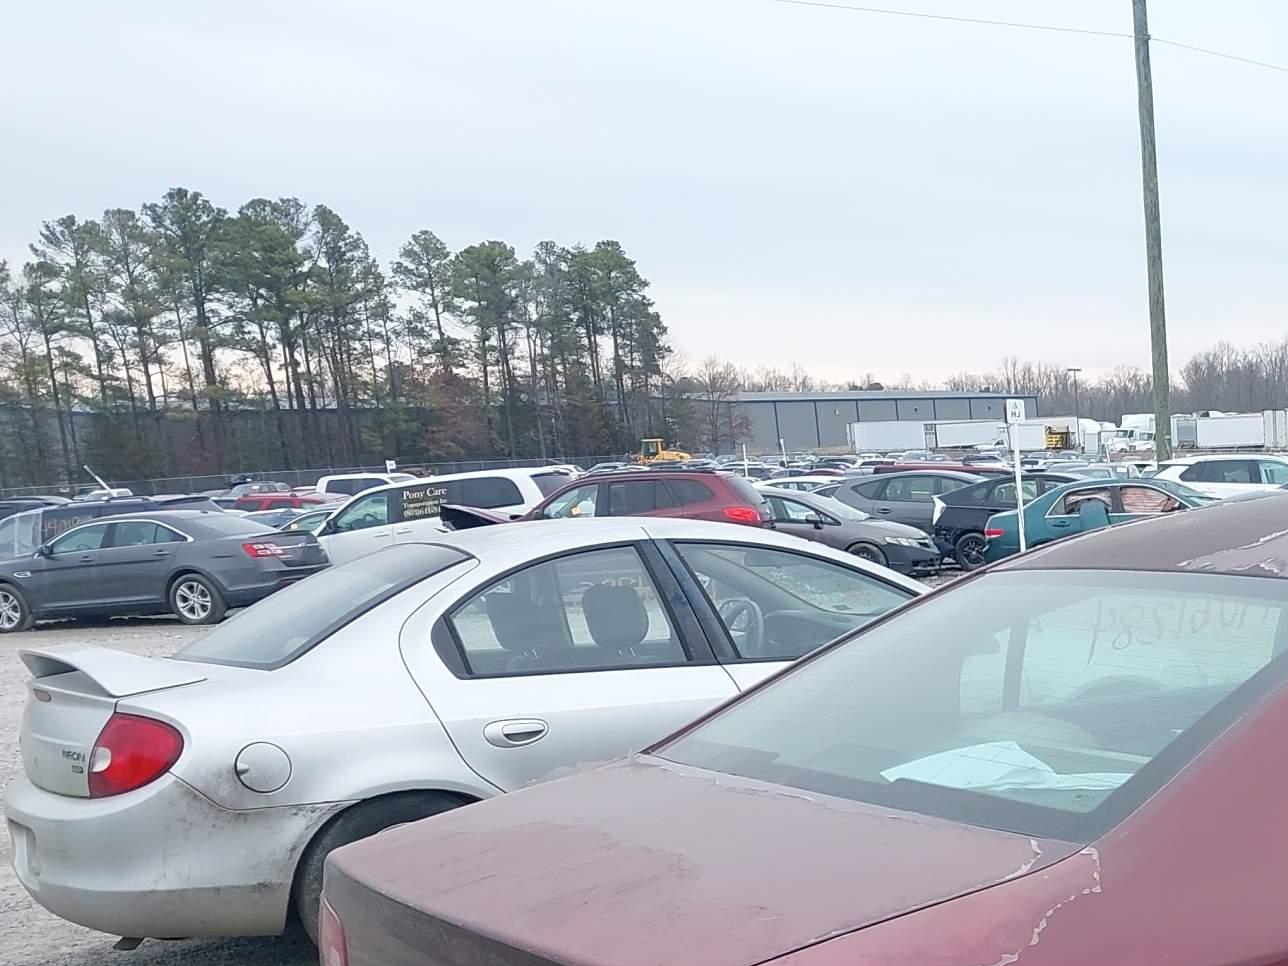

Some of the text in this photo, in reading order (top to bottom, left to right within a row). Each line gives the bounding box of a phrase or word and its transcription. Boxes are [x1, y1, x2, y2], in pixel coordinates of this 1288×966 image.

[403, 487, 448, 500] Pony Care
[62, 749, 86, 763] NEON
